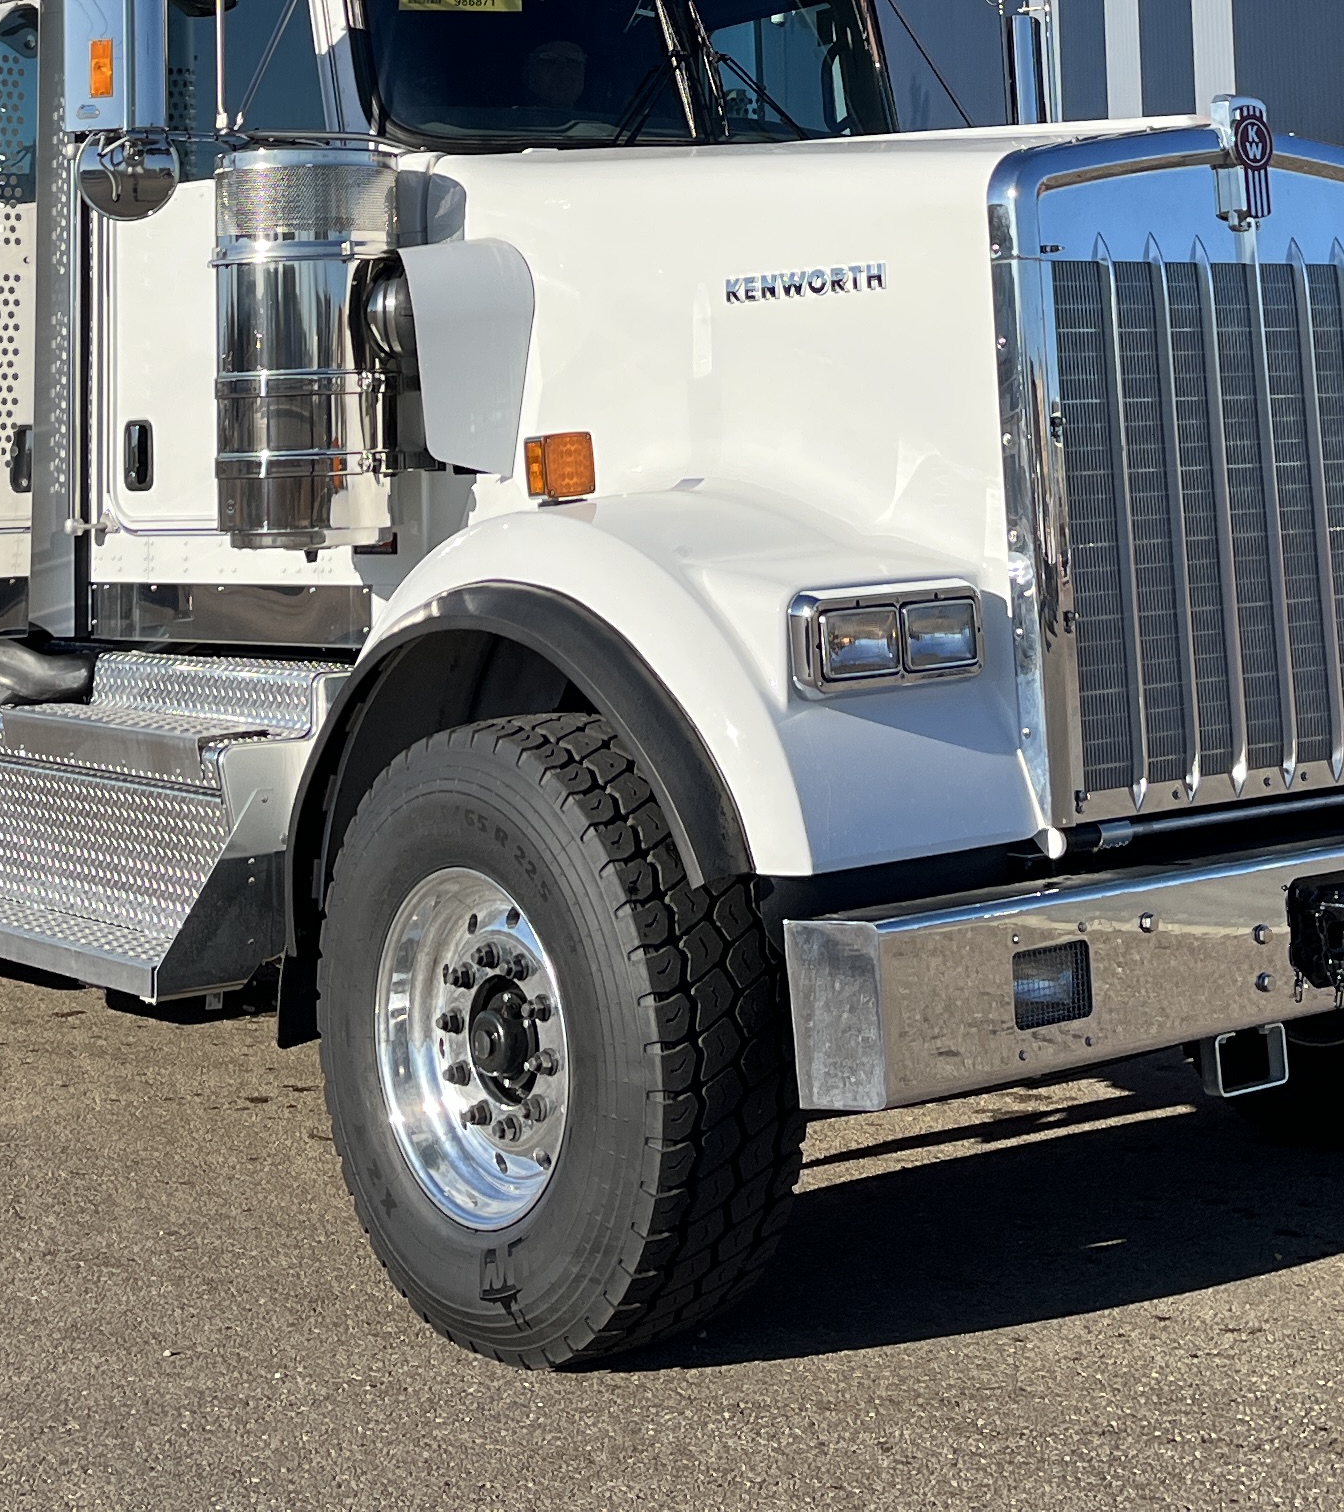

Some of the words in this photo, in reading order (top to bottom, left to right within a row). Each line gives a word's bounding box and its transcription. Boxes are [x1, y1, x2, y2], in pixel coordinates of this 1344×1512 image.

[1248, 125, 1260, 142] K
[1246, 142, 1263, 160] W
[725, 262, 888, 304] KENWORTH
